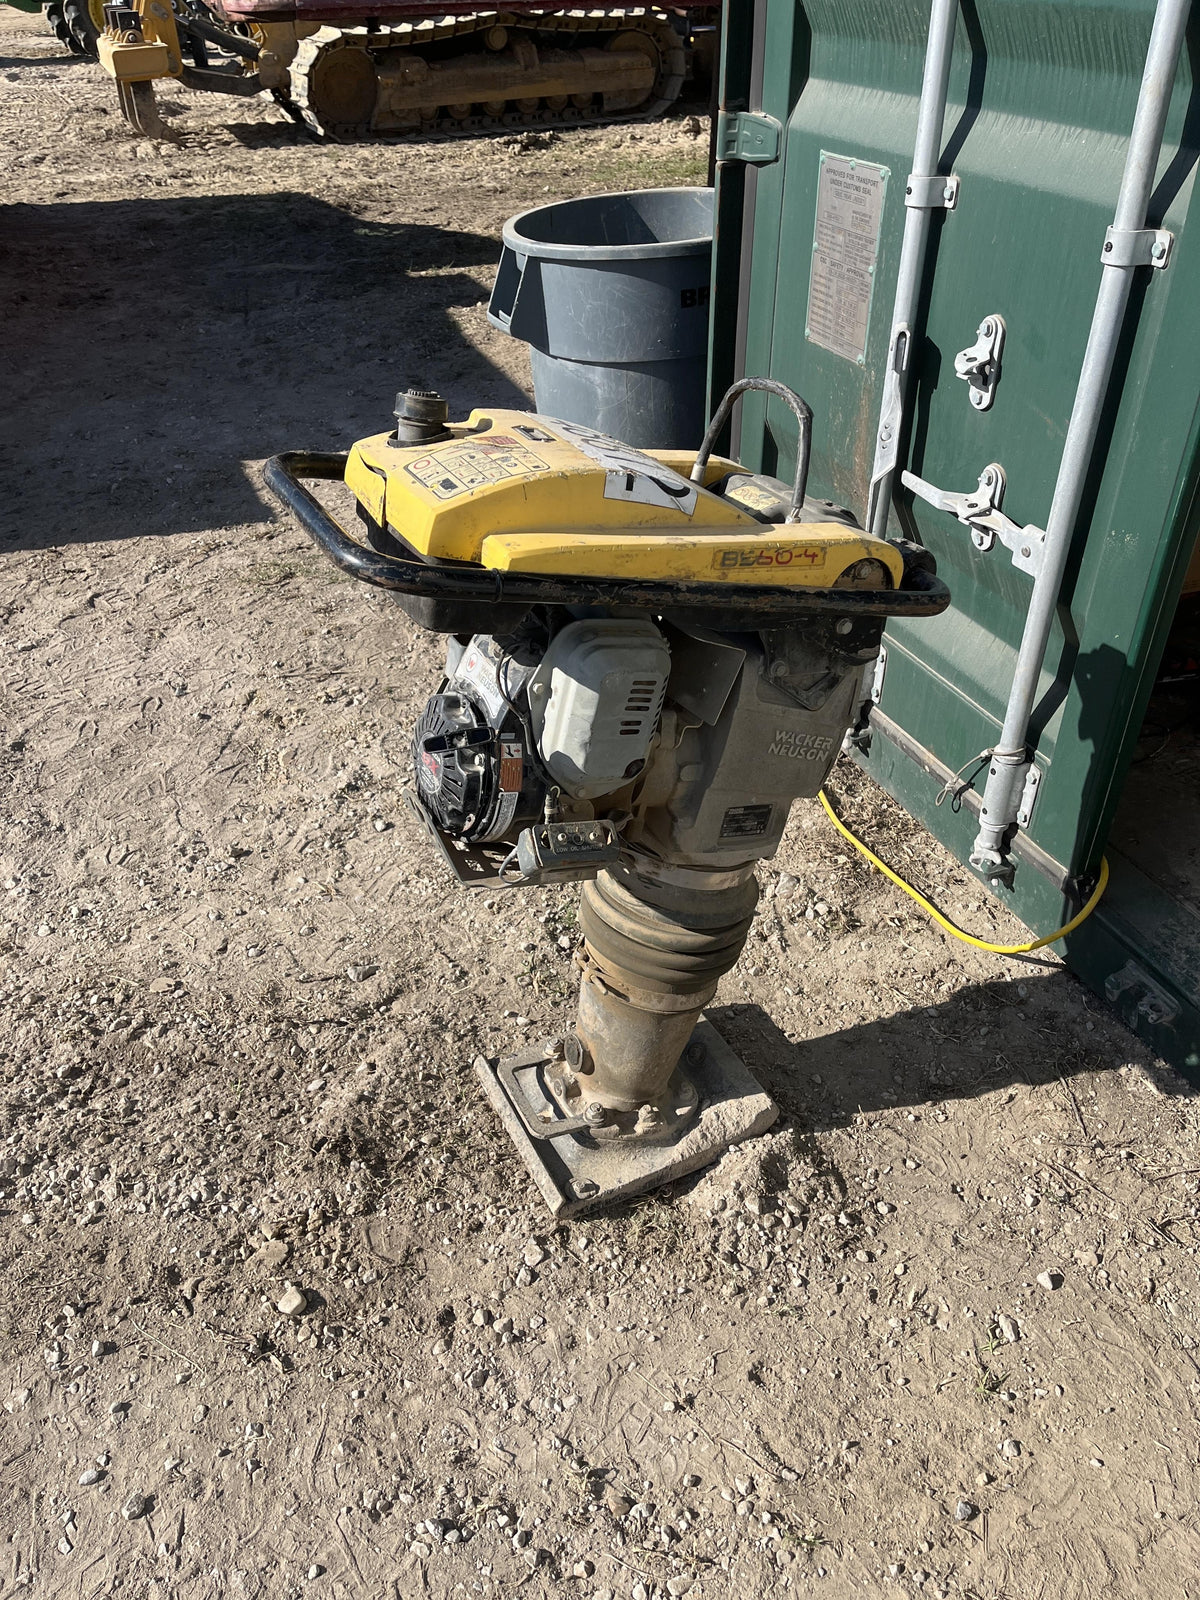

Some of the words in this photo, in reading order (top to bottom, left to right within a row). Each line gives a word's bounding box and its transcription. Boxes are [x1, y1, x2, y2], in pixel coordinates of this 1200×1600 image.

[826, 168, 846, 179] APPROVED
[847, 172, 855, 181] FOR
[855, 176, 878, 187] TRANSPORT
[830, 178, 843, 187] UNDER
[843, 181, 861, 193] CUSTOMS
[862, 187, 872, 196] SEAL
[830, 260, 844, 271] SAFETY
[846, 267, 865, 280] APPROVAL
[775, 730, 833, 750] WACKER
[768, 742, 829, 762] NEUSON
